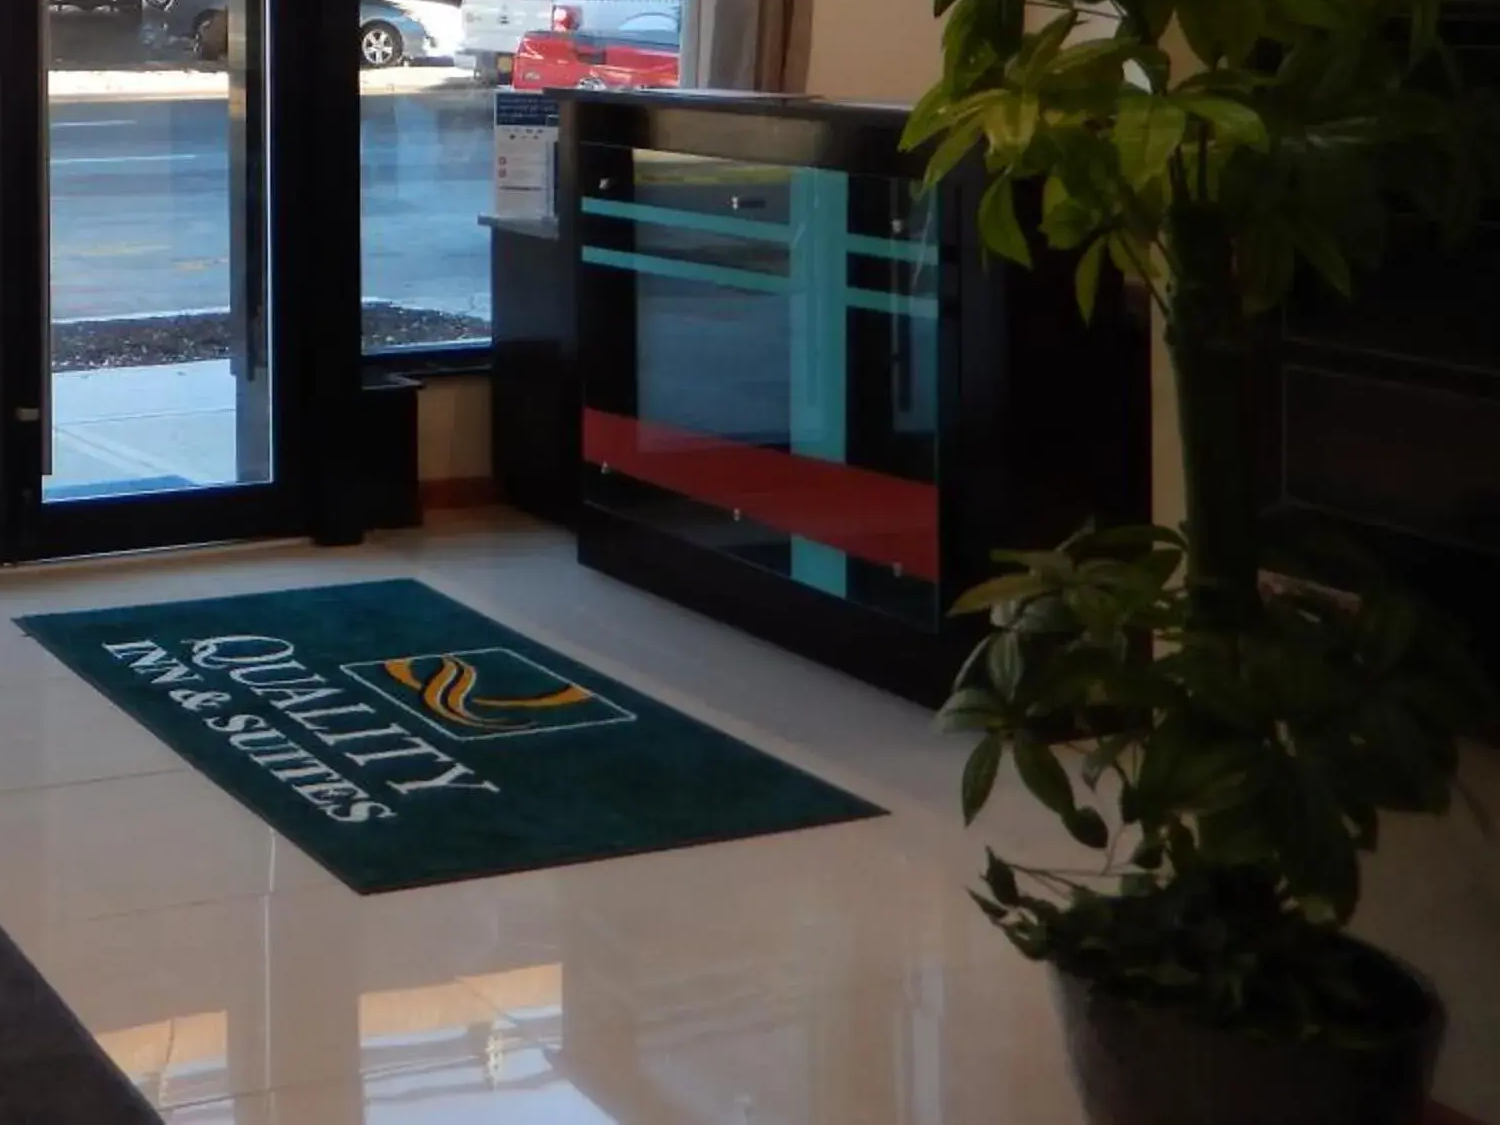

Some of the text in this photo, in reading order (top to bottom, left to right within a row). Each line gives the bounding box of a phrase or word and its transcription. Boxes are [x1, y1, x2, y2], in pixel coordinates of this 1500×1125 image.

[102, 639, 397, 822] INN & SUITES
[181, 635, 500, 794] QUALITY
